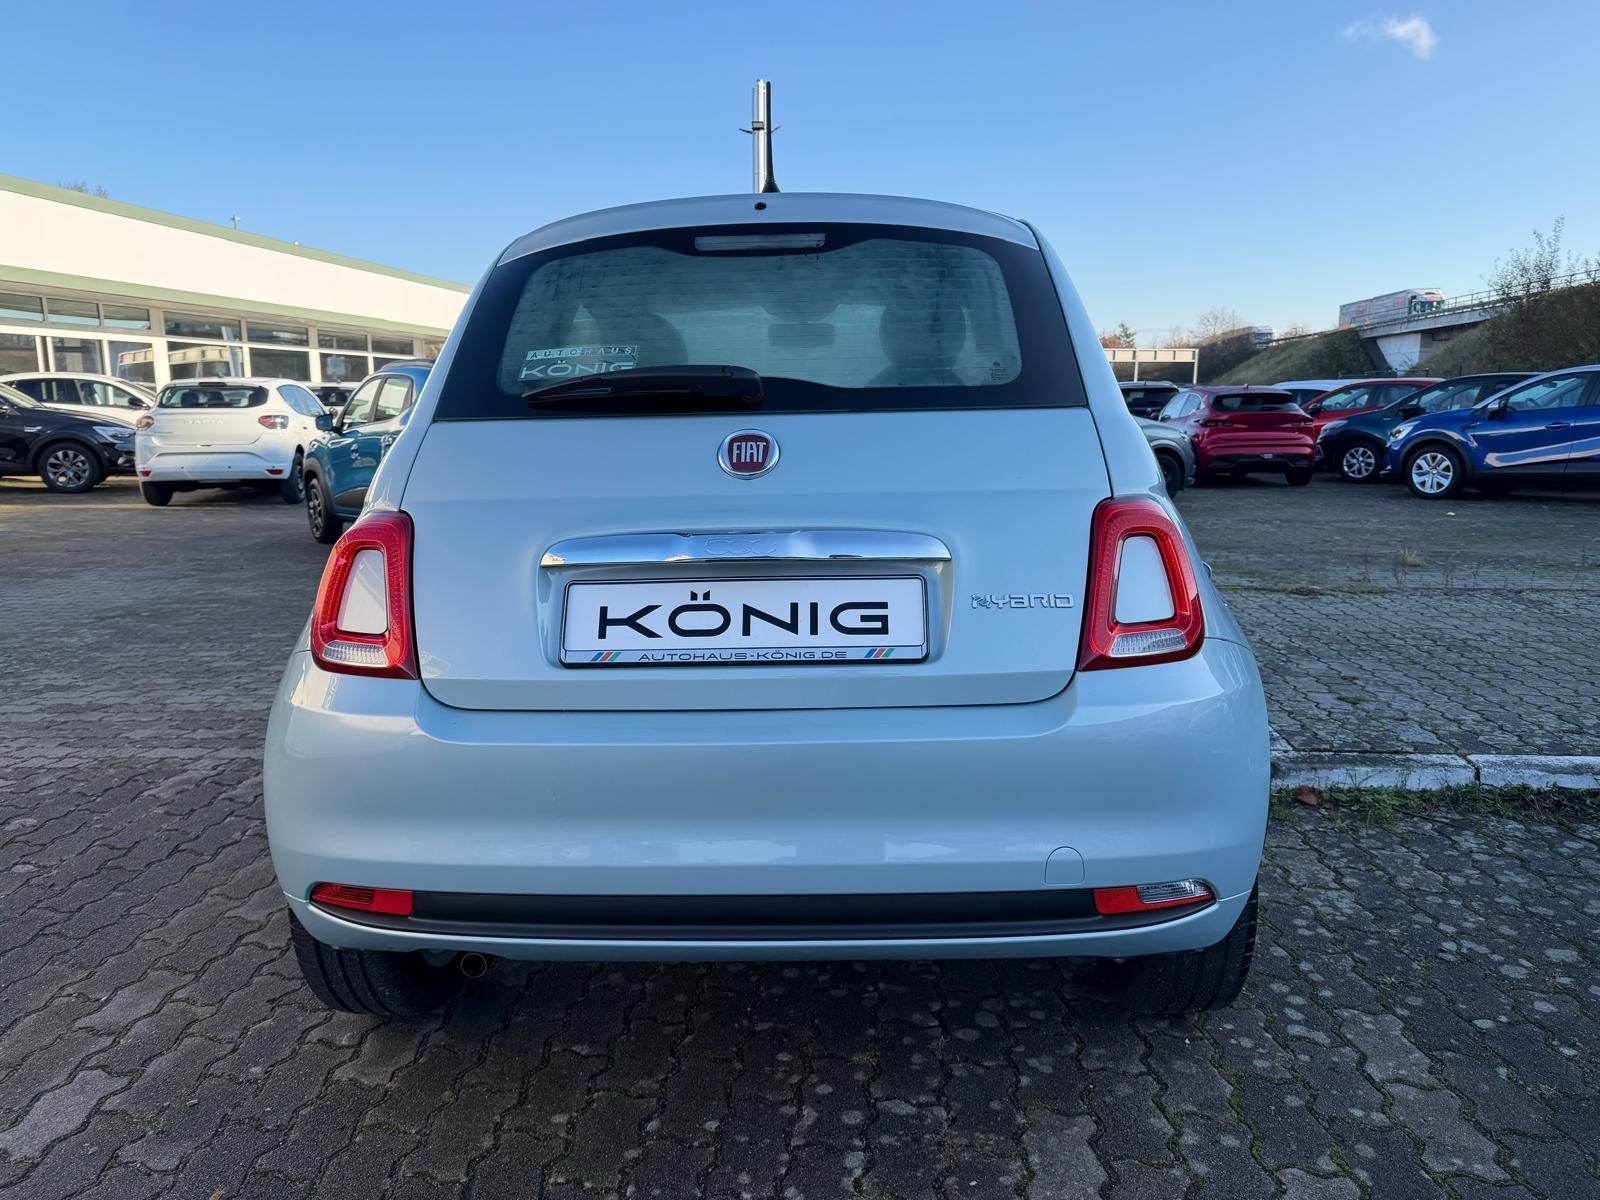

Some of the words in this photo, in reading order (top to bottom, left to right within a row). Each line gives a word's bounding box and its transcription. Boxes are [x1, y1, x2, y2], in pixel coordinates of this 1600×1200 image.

[530, 347, 633, 359] AUTOHAUS
[520, 360, 634, 379] KÖNIG
[732, 441, 767, 463] FIAT
[970, 593, 1074, 609] HYBRID
[597, 590, 889, 640] KÖNIG
[638, 649, 848, 662] AUTOHAUS-KÖNIG.DE
